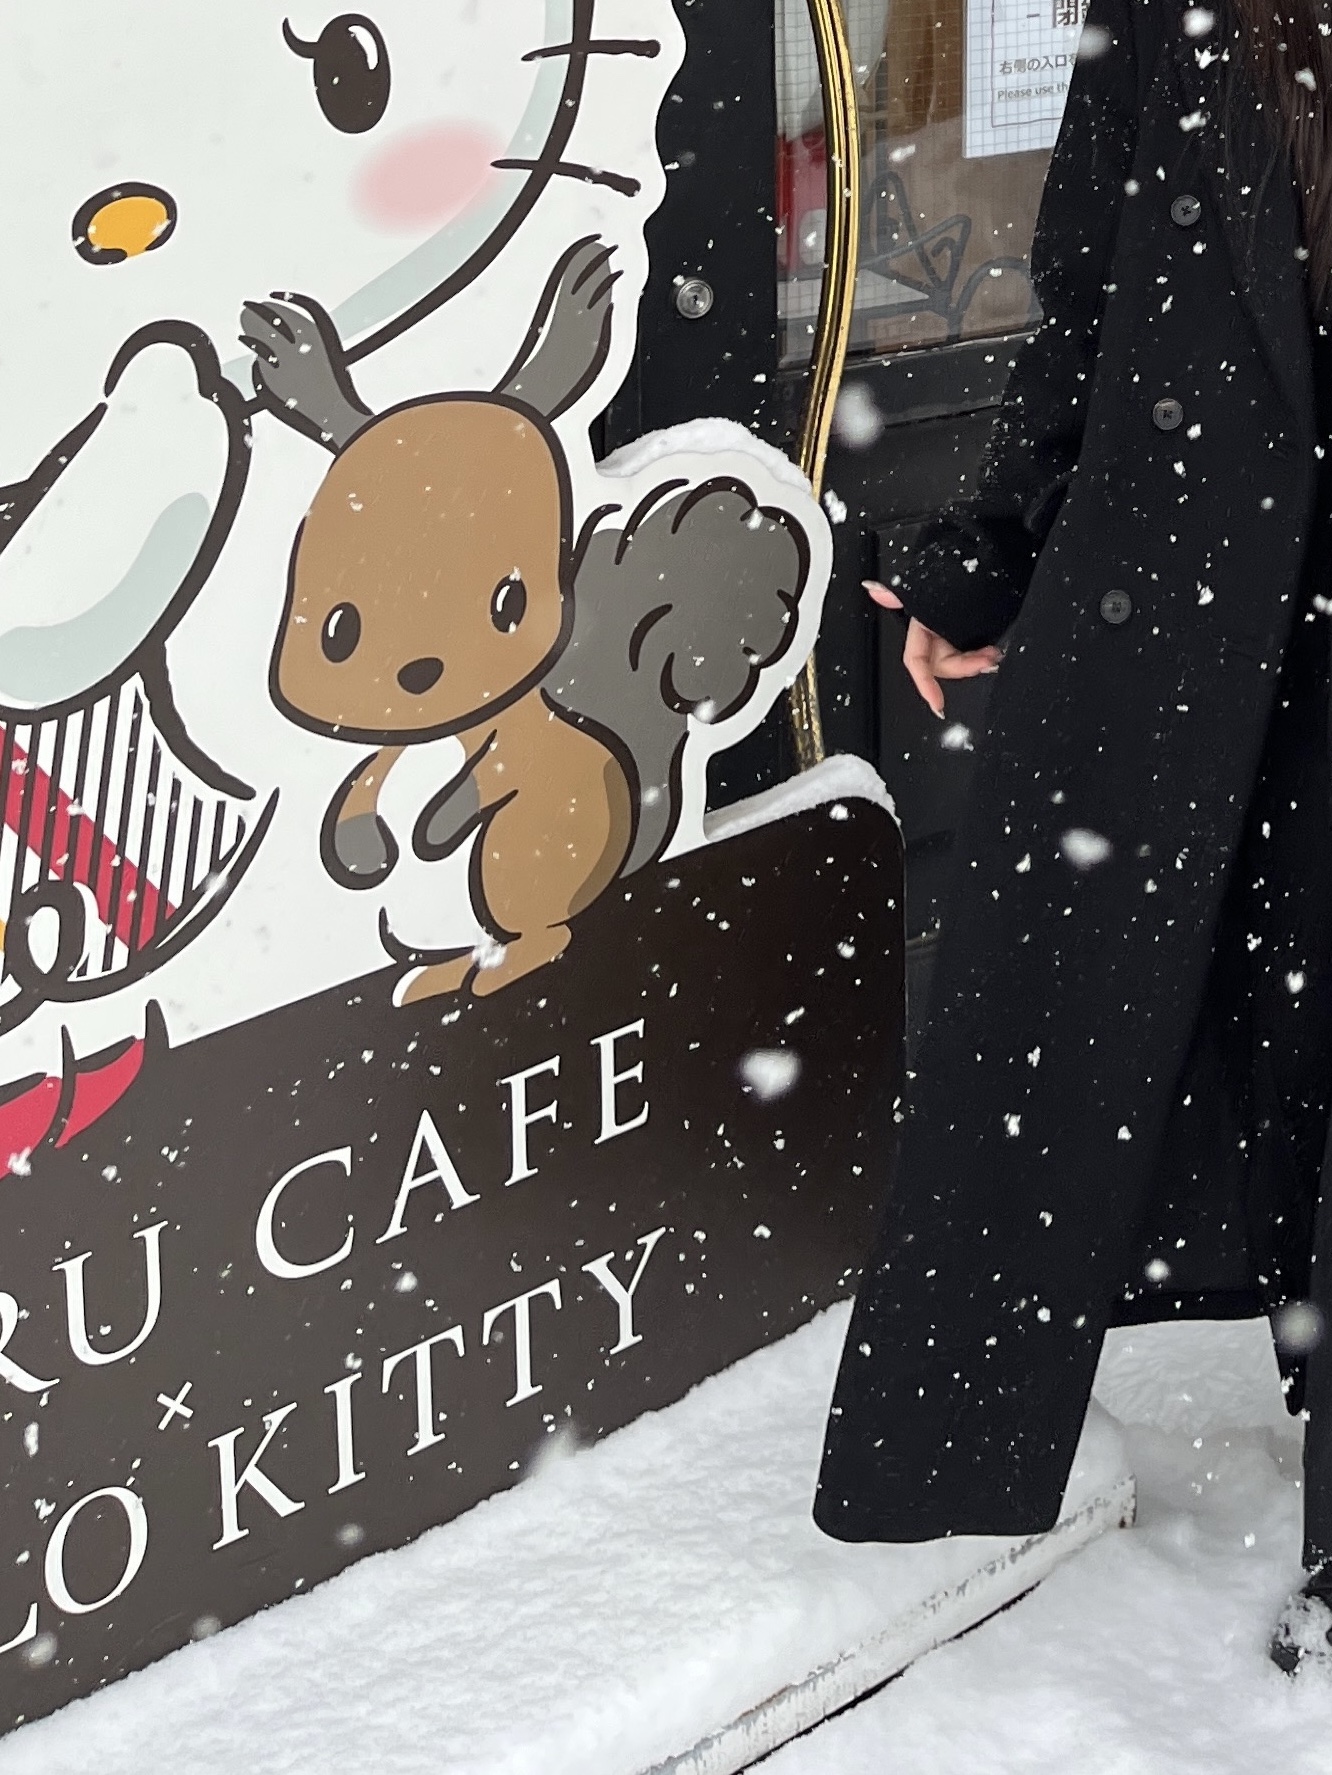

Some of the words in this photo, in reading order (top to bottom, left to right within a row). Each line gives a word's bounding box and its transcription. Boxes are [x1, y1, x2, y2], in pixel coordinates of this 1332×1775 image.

[998, 88, 1032, 100] Please
[1035, 84, 1054, 95] use
[1057, 82, 1069, 92] th
[255, 1018, 650, 1280] CAFE
[208, 1226, 667, 1550] KITTY
